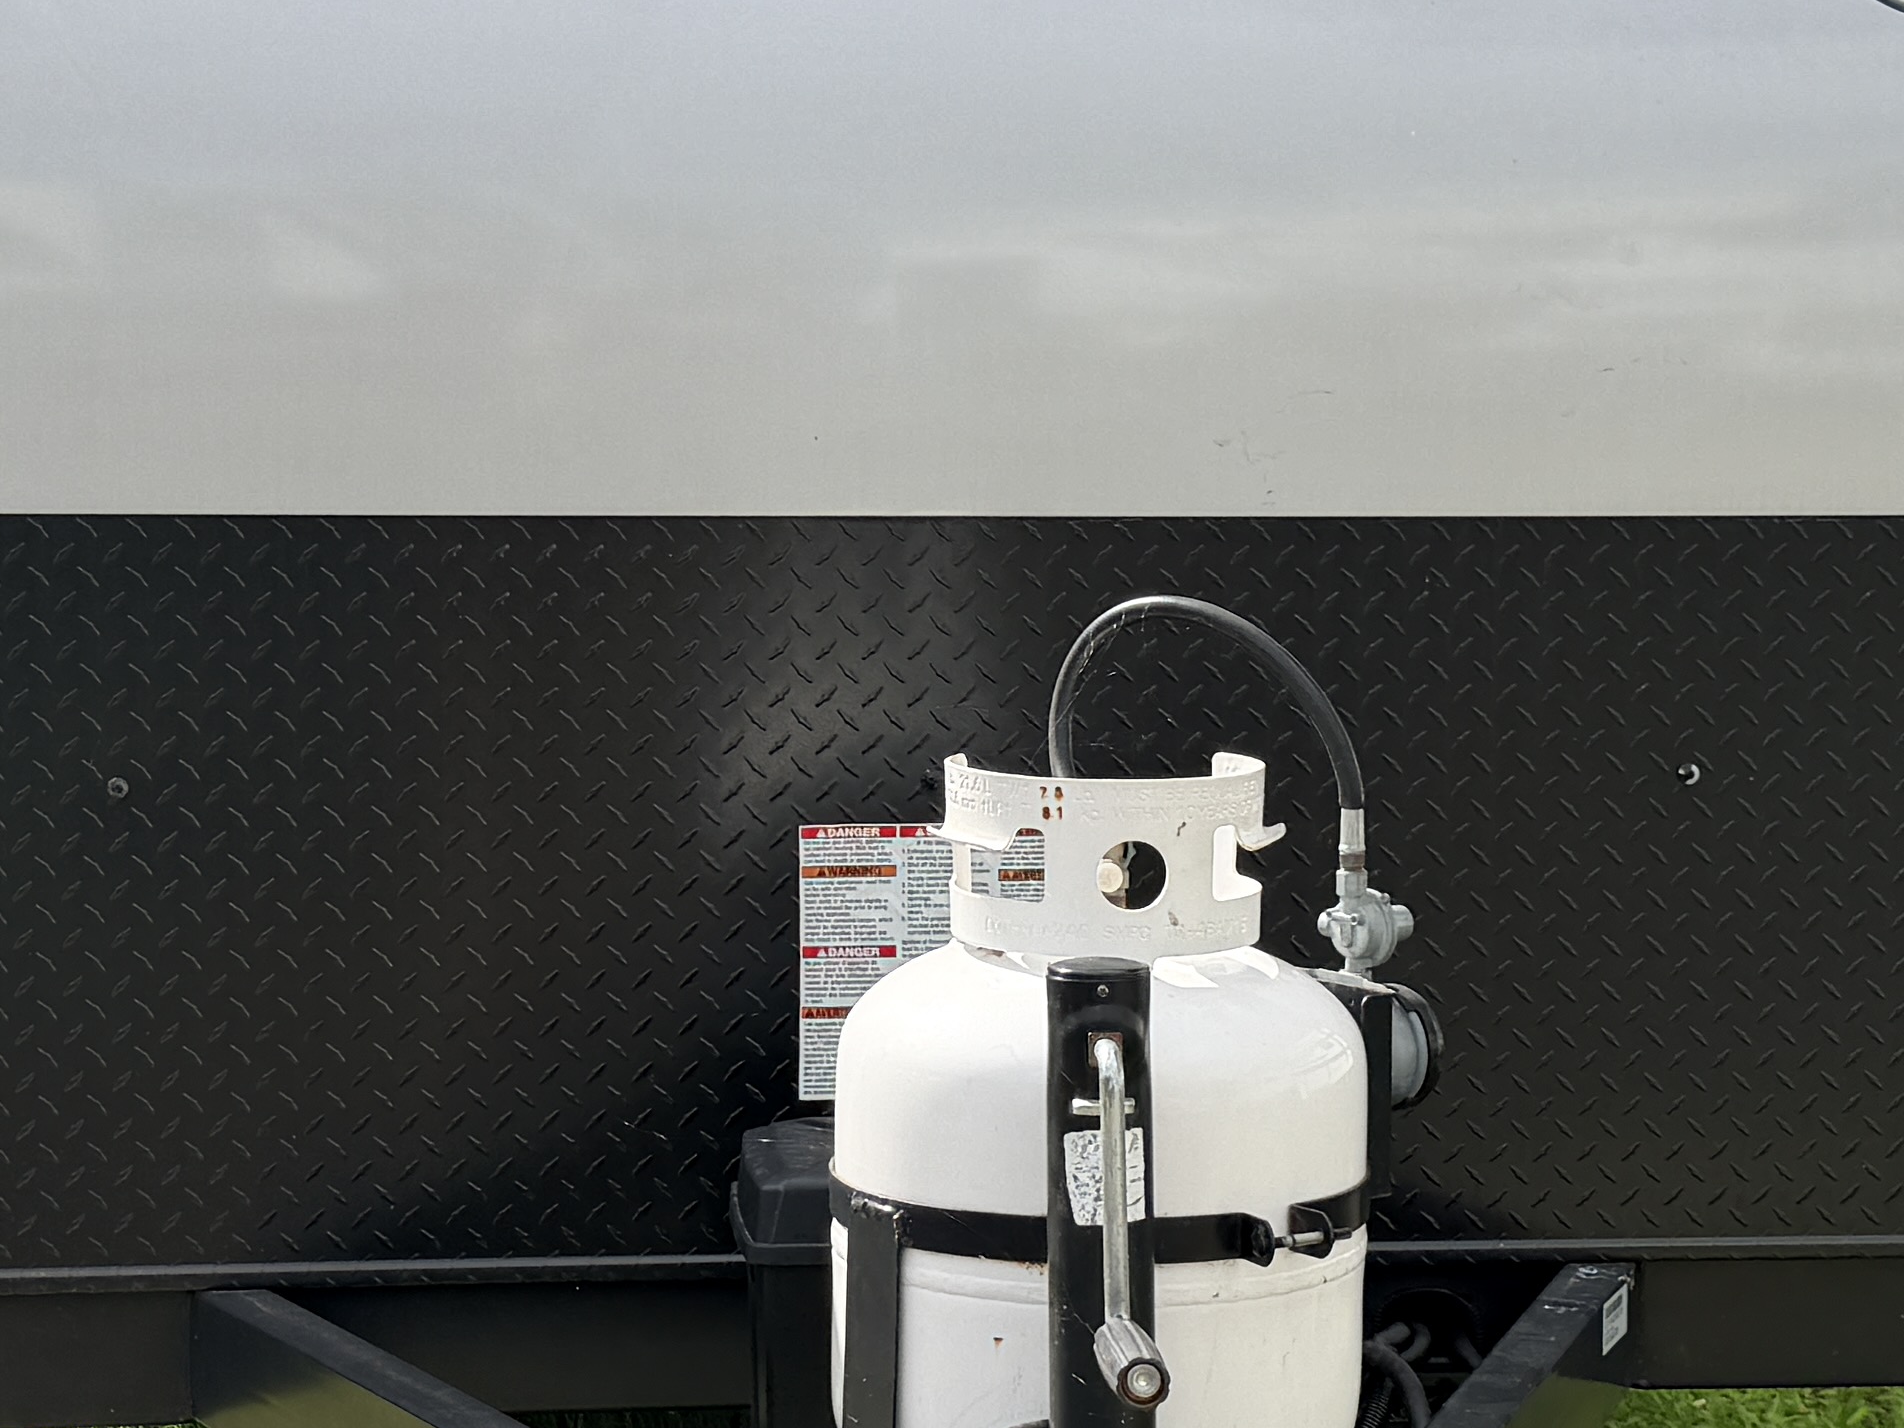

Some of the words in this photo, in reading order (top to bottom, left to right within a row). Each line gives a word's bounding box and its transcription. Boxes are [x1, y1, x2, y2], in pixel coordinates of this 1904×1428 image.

[827, 827, 881, 838] DANGER
[826, 866, 882, 878] WARNING
[827, 947, 880, 958] DANGER
